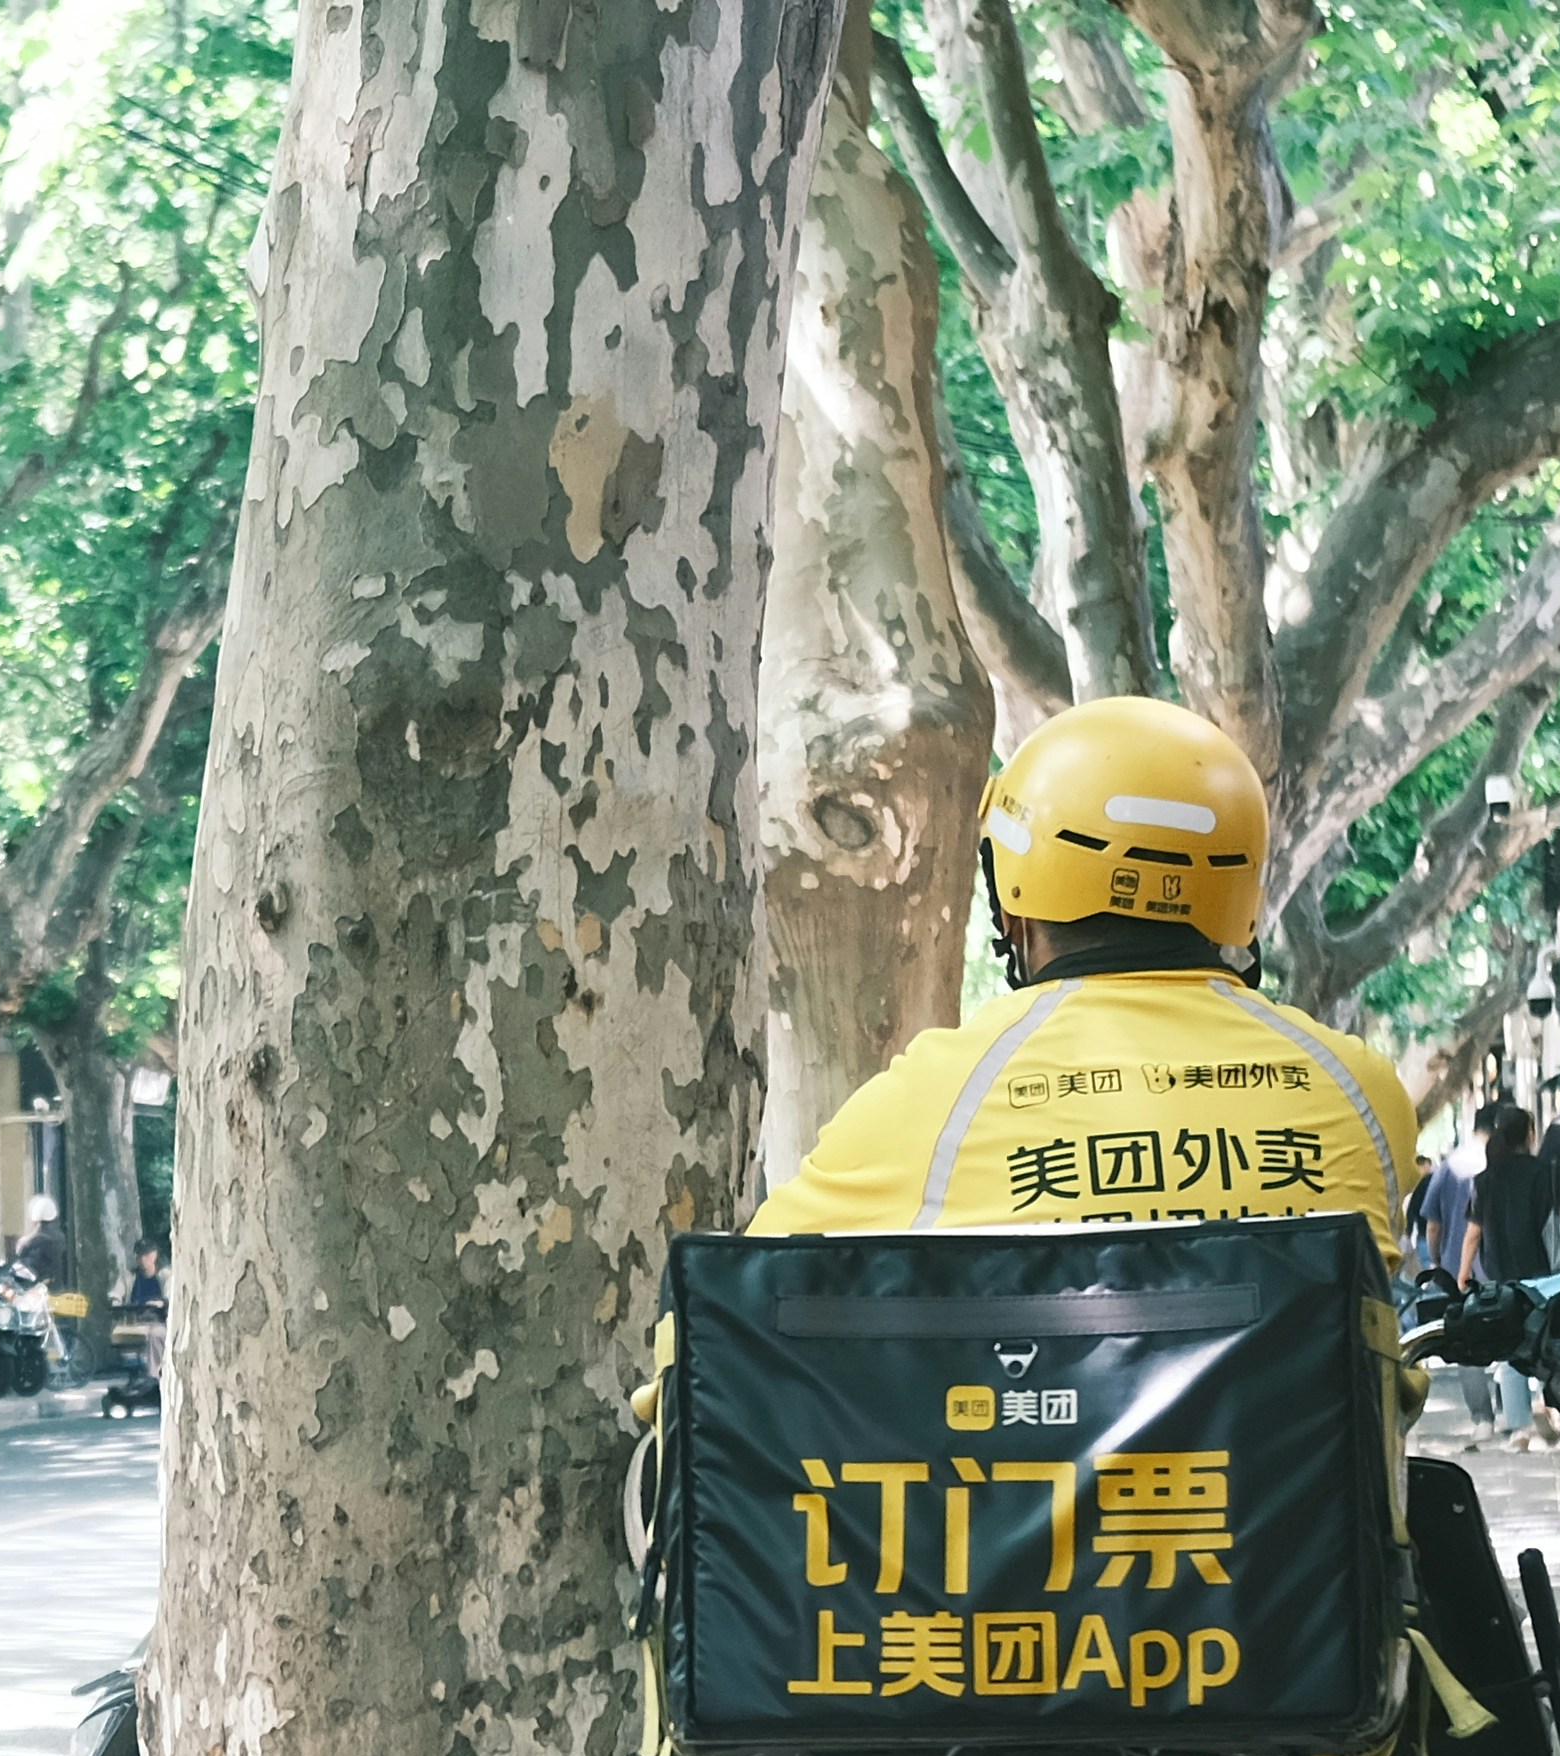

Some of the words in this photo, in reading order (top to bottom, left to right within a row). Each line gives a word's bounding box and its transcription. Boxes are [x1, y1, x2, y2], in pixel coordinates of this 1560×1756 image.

[1057, 1069, 1123, 1099] 美团
[1183, 1063, 1312, 1092] 美团外卖
[1007, 1127, 1326, 1212] 美团外卖
[1001, 1389, 1079, 1426] 美团
[792, 1450, 1235, 1595] 订门票
[786, 1610, 1241, 1707] 上美团App
